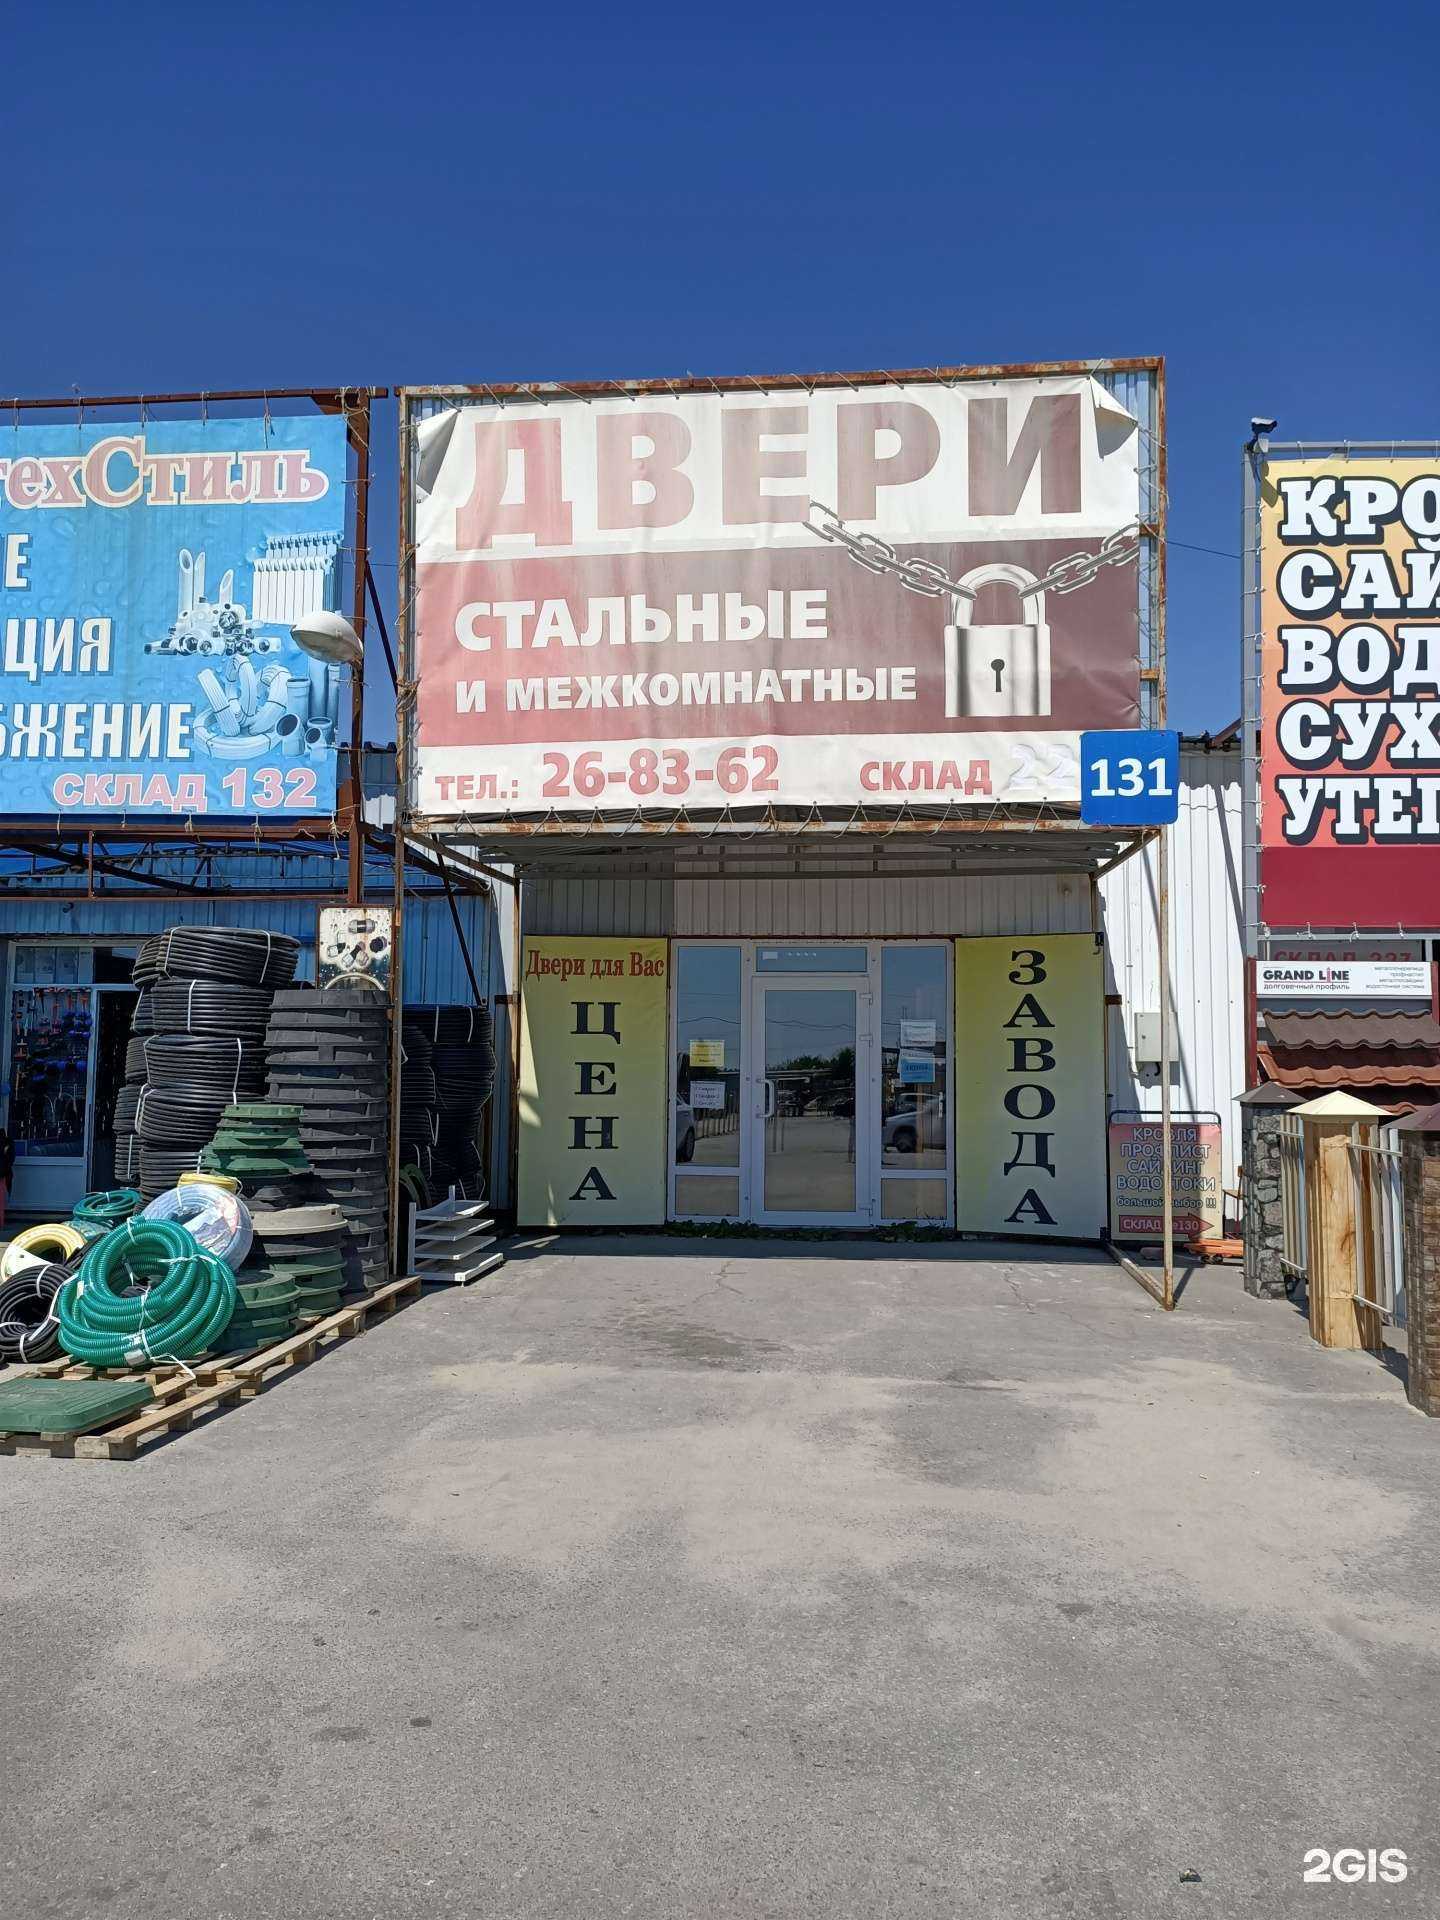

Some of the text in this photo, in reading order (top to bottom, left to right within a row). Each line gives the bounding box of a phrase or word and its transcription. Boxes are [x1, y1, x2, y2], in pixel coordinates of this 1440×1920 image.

[455, 393, 1082, 550] ДВЕРИ
[454, 589, 828, 651] СТАЛЬНЫЕ
[456, 667, 917, 713] И МЕЖКОМНАТНЫЕ
[0, 703, 192, 760] ЖЕНИЕ
[54, 768, 317, 812] СКЛАД 132
[434, 774, 519, 800] ТЕЛ.:
[542, 745, 779, 799] 26-83-62
[860, 758, 992, 796] СКЛАД
[1090, 757, 1173, 798] 131
[526, 950, 665, 981] Двери для Вас
[1263, 970, 1315, 981] GRAND
[567, 1001, 621, 1201] ЦЕНА
[1002, 949, 1058, 1226] ЗАВОДА
[1116, 1175, 1216, 1192] ВОДОТОКИ
[1127, 1155, 1205, 1174] САЙИНГ
